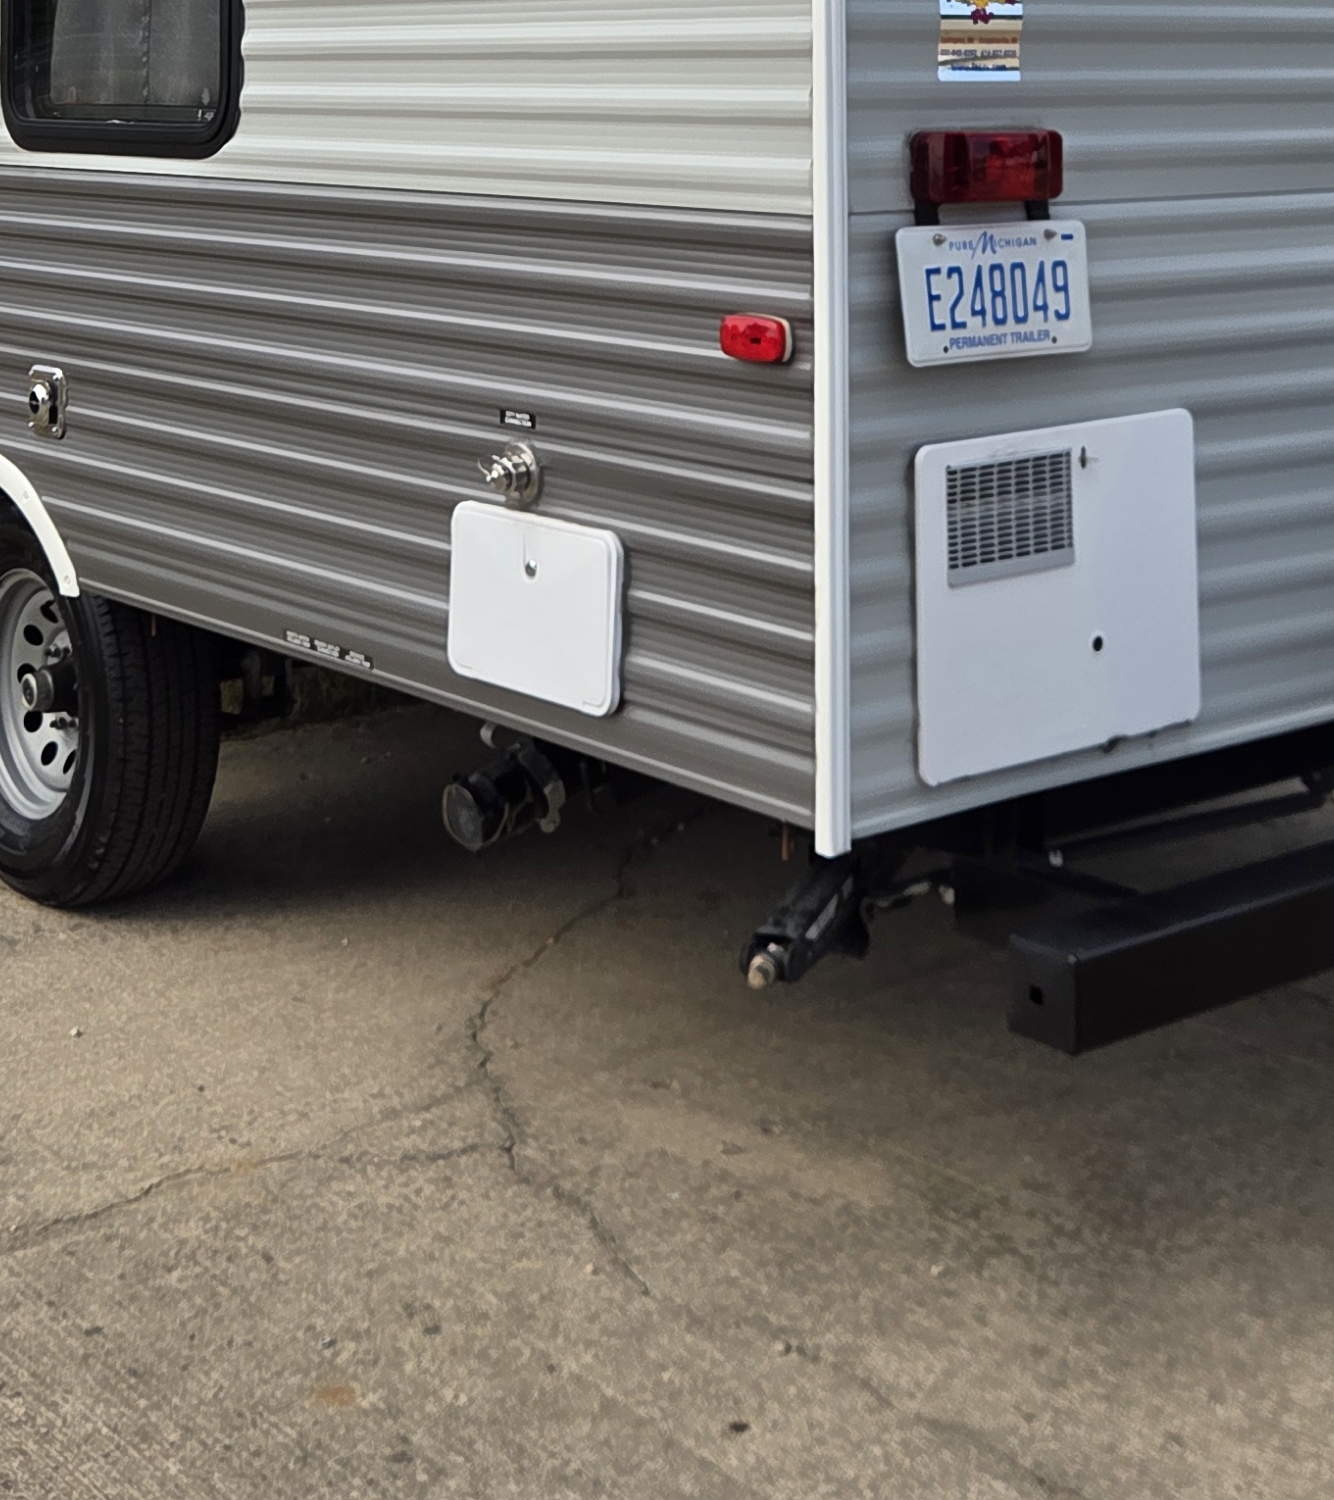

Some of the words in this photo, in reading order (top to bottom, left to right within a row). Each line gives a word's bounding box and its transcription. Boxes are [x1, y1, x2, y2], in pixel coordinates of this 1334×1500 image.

[948, 239, 975, 252] PURE
[924, 260, 1071, 332] E248049
[949, 333, 1008, 350] PERMANENT
[1010, 329, 1051, 344] TRAILER
